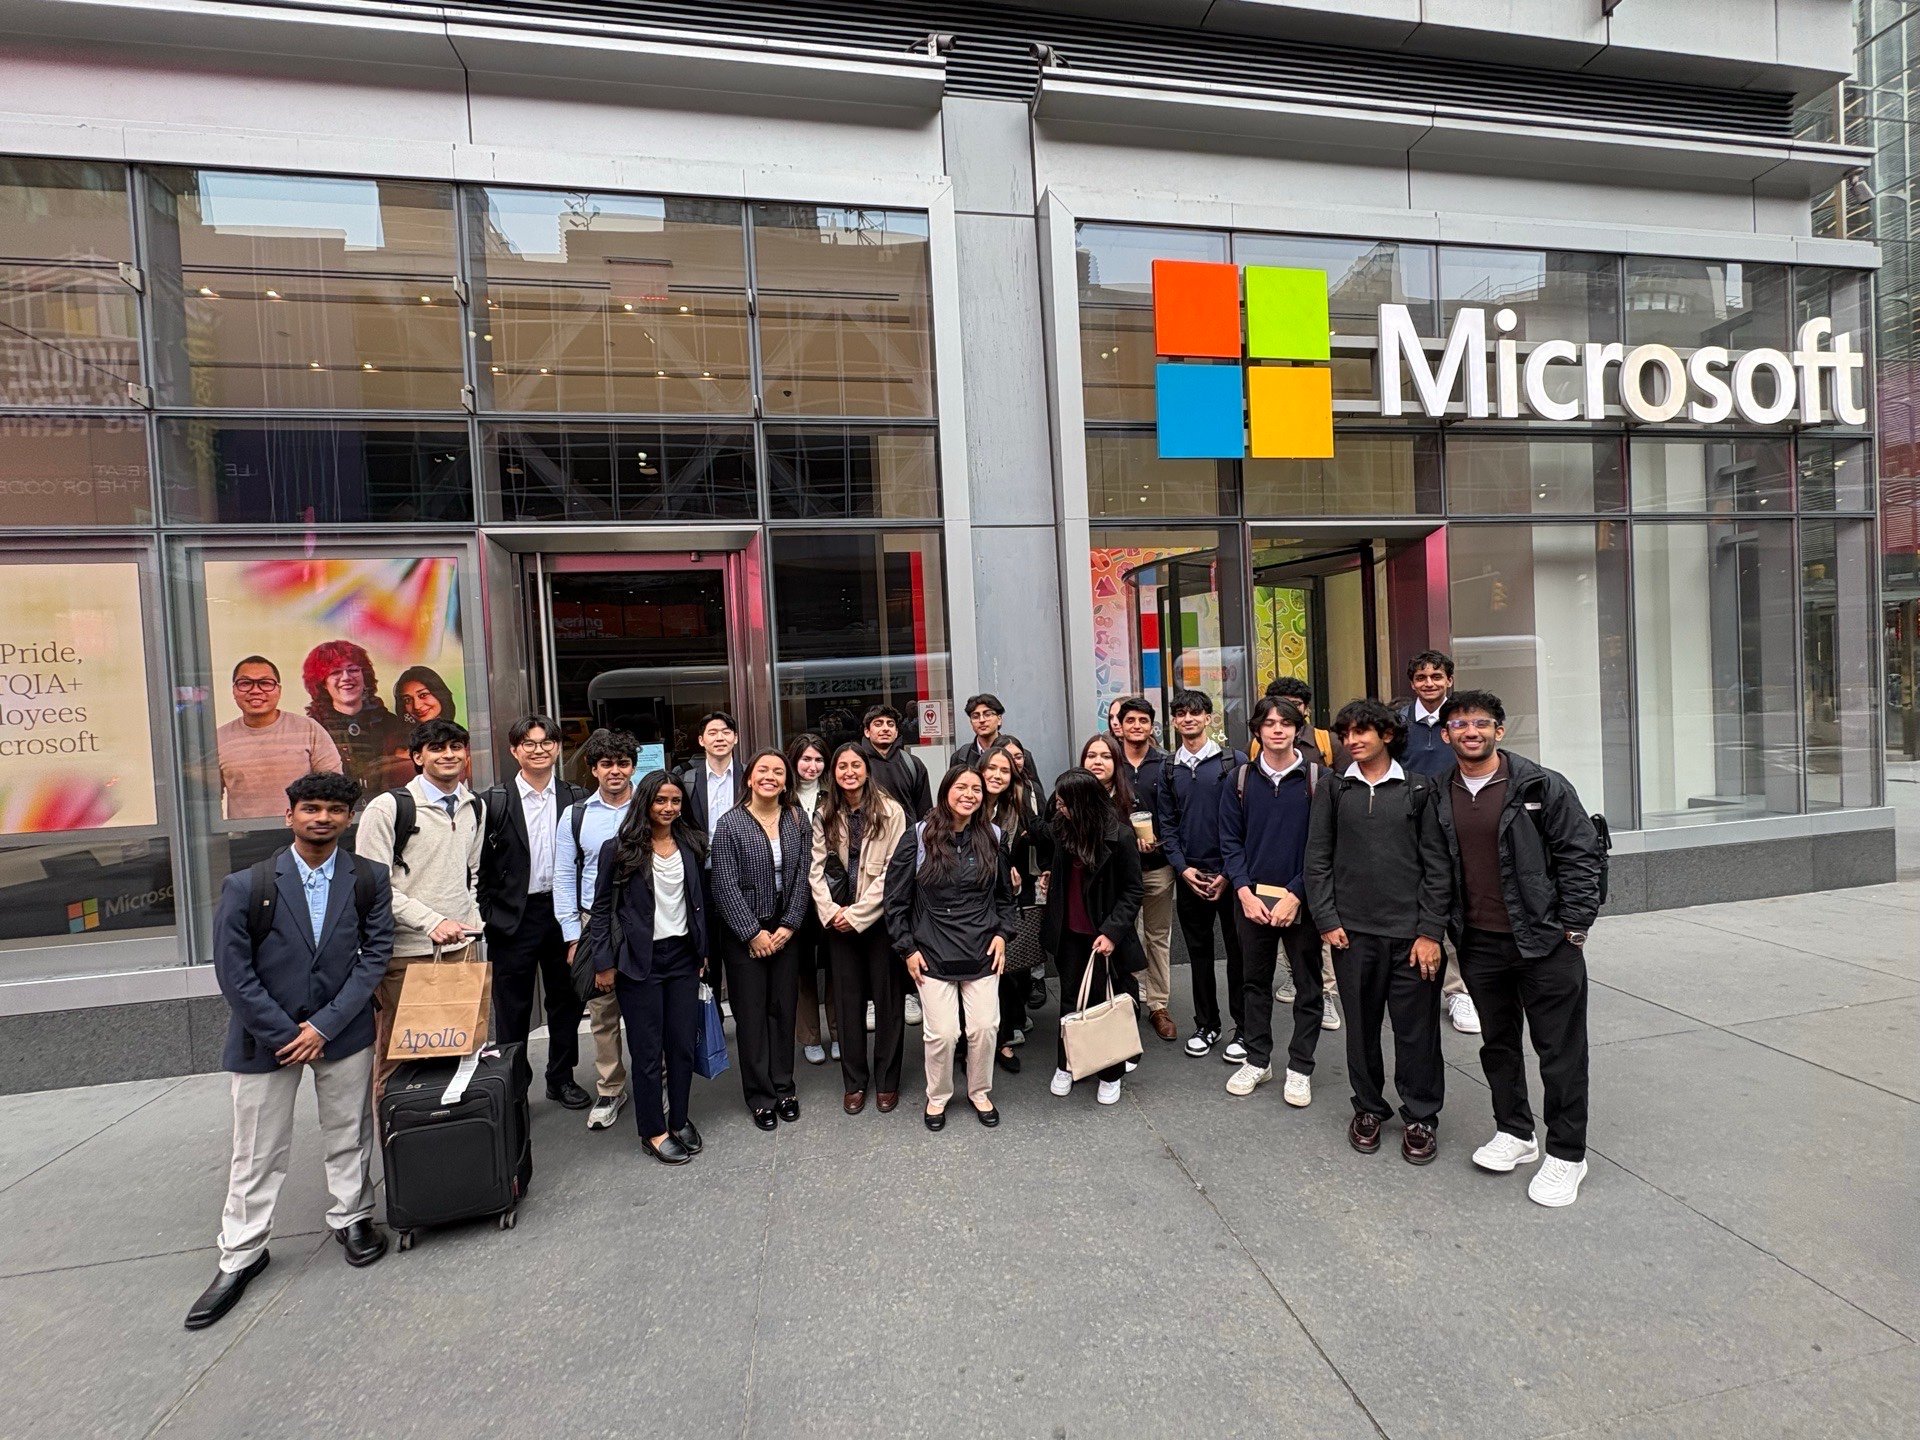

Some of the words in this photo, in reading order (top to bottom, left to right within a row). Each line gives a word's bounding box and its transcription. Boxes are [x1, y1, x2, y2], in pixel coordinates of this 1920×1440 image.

[1378, 303, 1867, 425] Microsoft
[0, 641, 82, 665] Pride,
[0, 730, 99, 756] crosoft
[396, 1028, 467, 1053] Apollo
